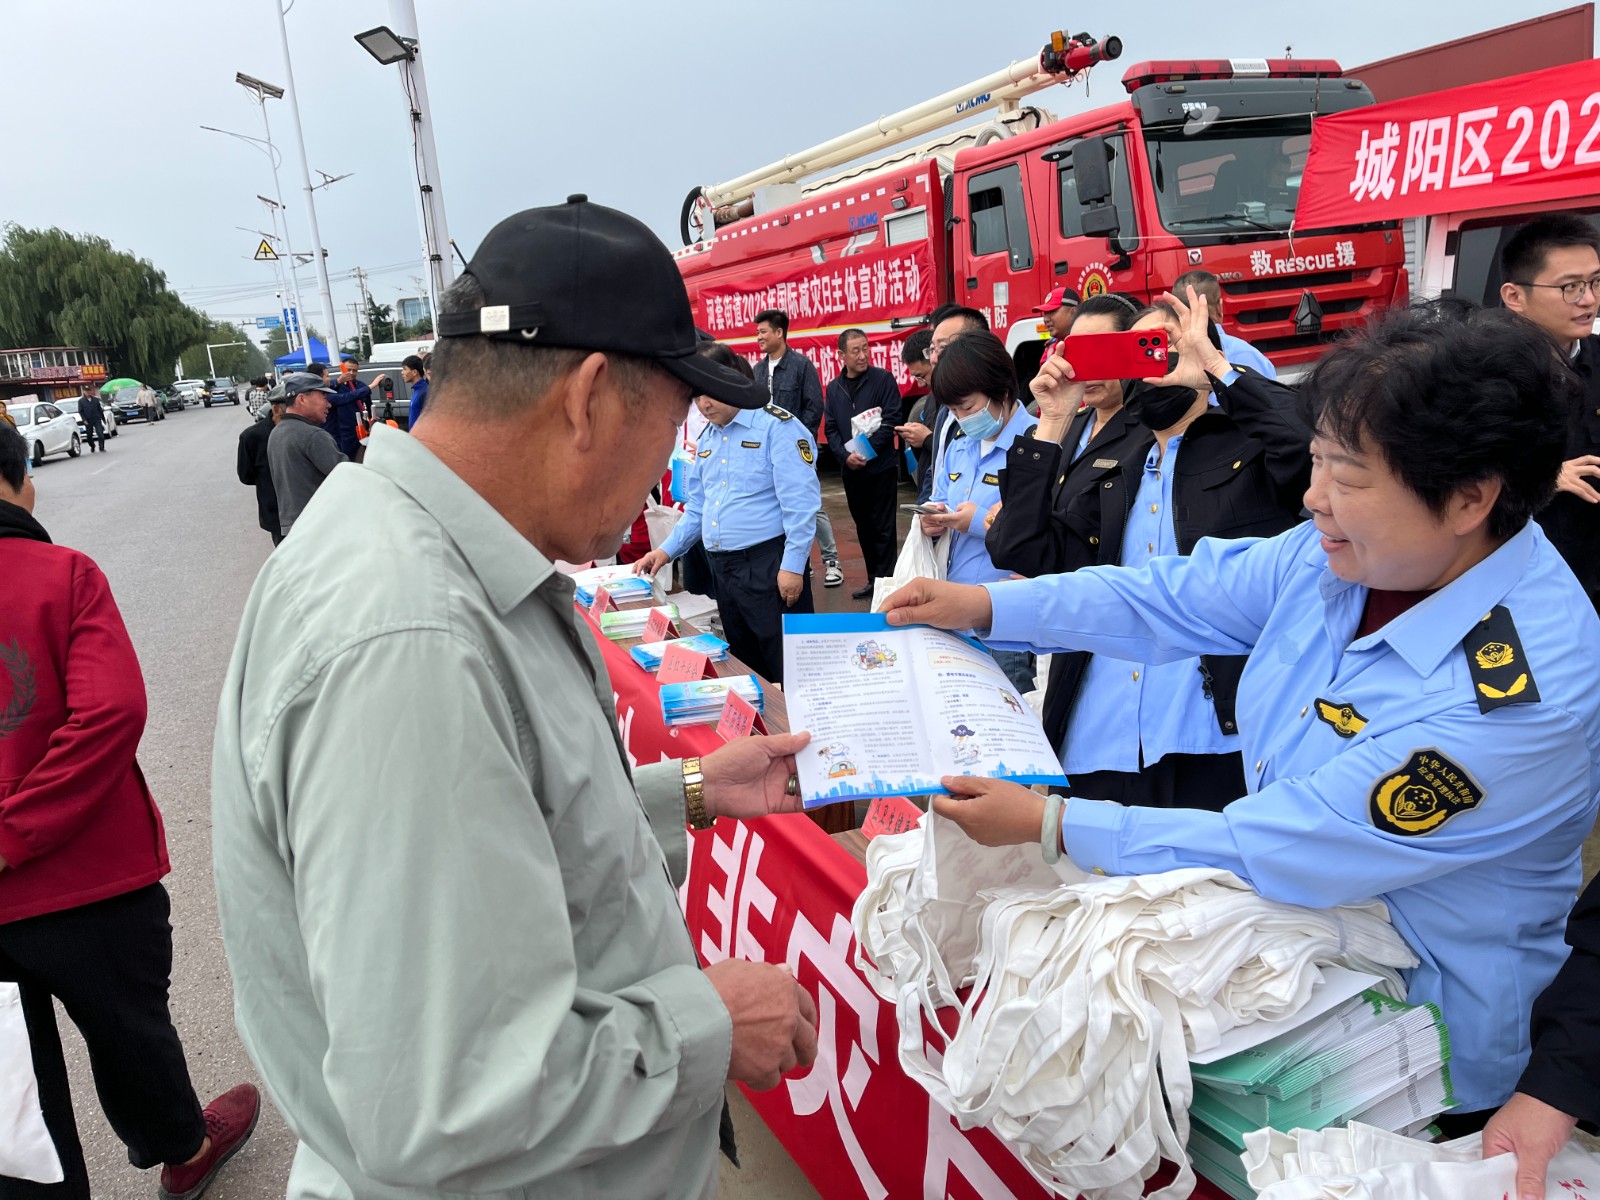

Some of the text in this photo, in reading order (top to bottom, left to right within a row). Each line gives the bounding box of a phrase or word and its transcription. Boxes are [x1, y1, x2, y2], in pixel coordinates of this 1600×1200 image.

[1349, 91, 1600, 203] 城阳区202
[1250, 241, 1356, 276] 救 RESCUE 援
[1417, 766, 1462, 806] 应急管理执法
[1418, 755, 1475, 805] 中华人民共和国
